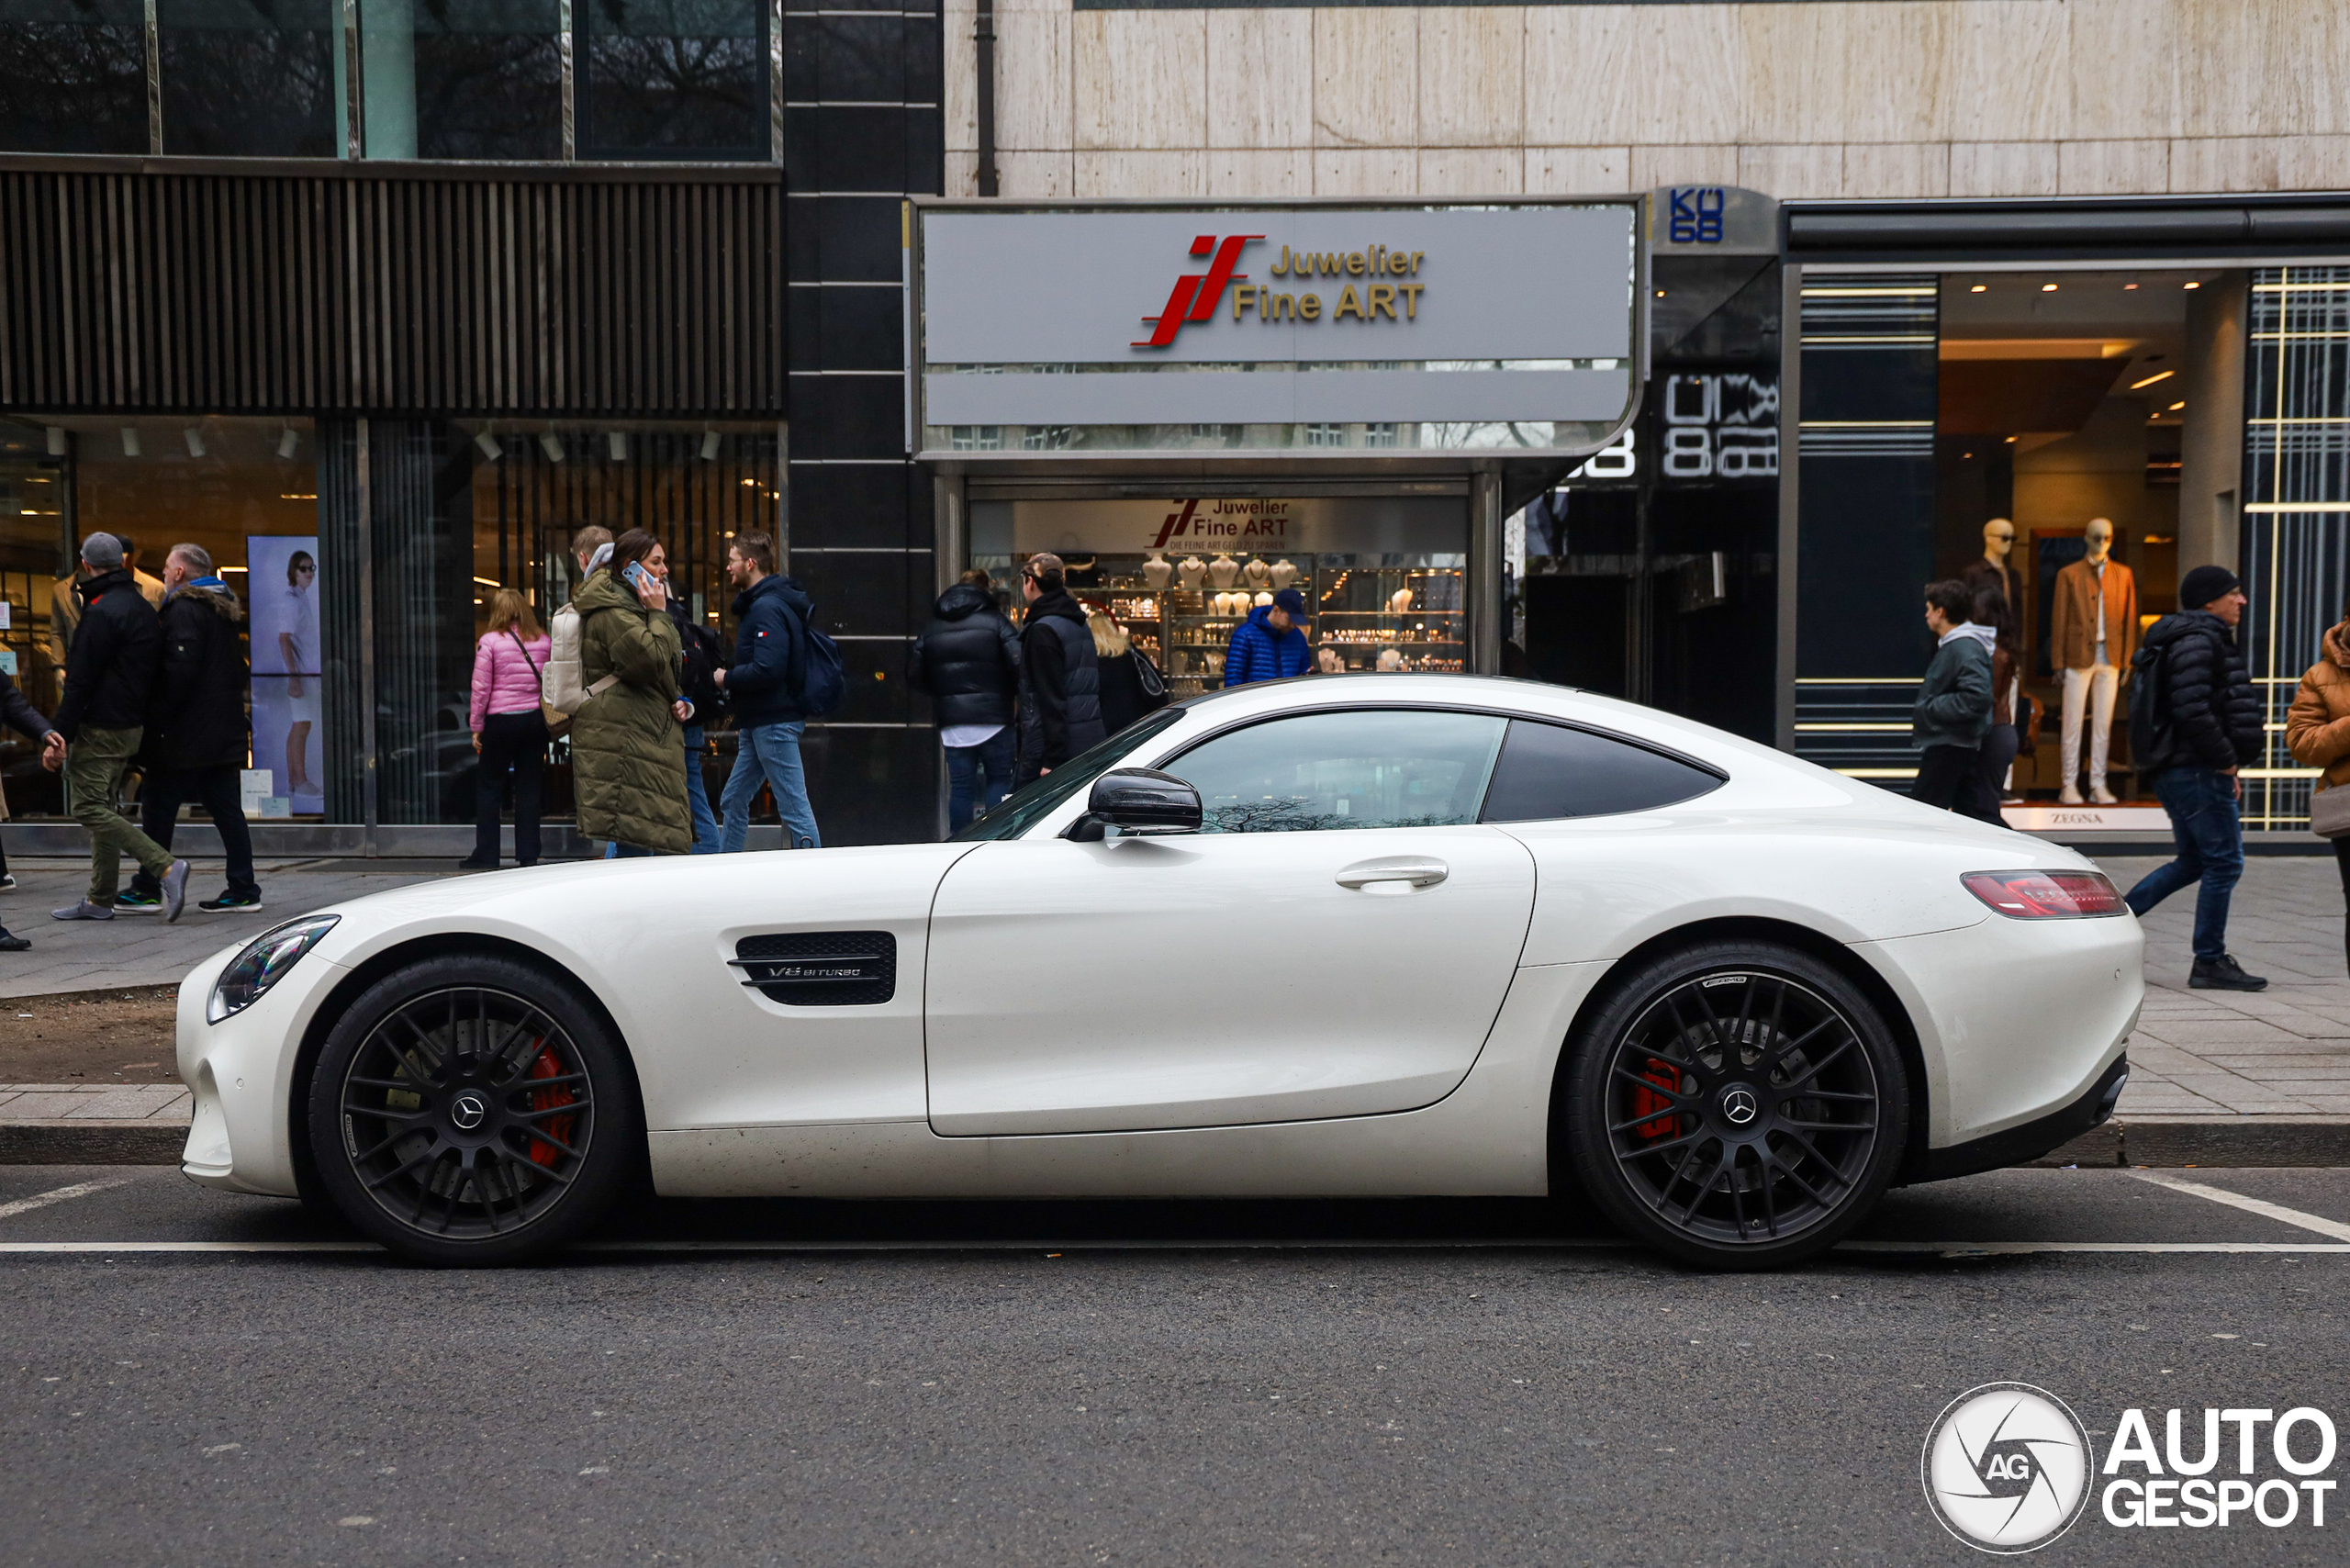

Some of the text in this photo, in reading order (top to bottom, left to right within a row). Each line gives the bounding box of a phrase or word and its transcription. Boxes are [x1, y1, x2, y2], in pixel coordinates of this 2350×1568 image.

[1671, 216, 1723, 241] 68
[1270, 244, 1425, 275] Juwelier
[1233, 284, 1425, 319] Fine ART
[1213, 499, 1288, 514] Juwelier
[1194, 519, 1288, 536] Fine ART
[1170, 542, 1182, 550] DIE
[1184, 542, 1205, 550] FEINE
[1207, 542, 1221, 550] ART
[1256, 542, 1285, 550] SPAREN
[2051, 813, 2103, 823] ZEGNA
[769, 967, 800, 976] V8
